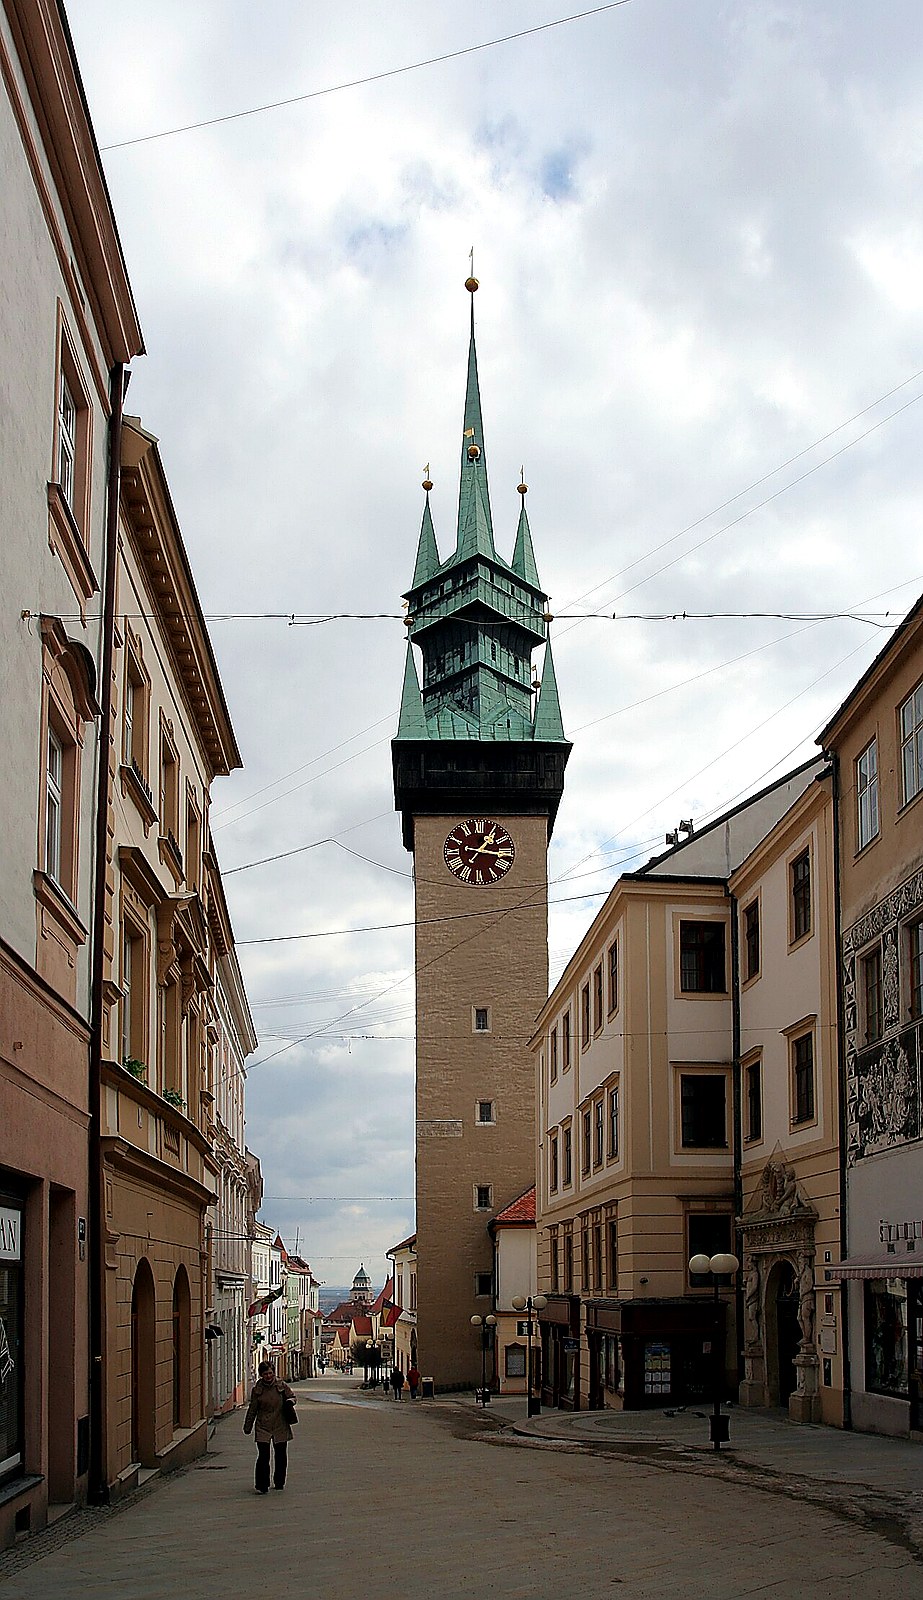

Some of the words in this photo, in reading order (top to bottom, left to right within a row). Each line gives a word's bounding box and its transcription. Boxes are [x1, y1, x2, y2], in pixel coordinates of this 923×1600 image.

[475, 821, 484, 834] XII
[495, 835, 509, 845] II
[446, 848, 460, 856] IX
[476, 870, 484, 882] VI
